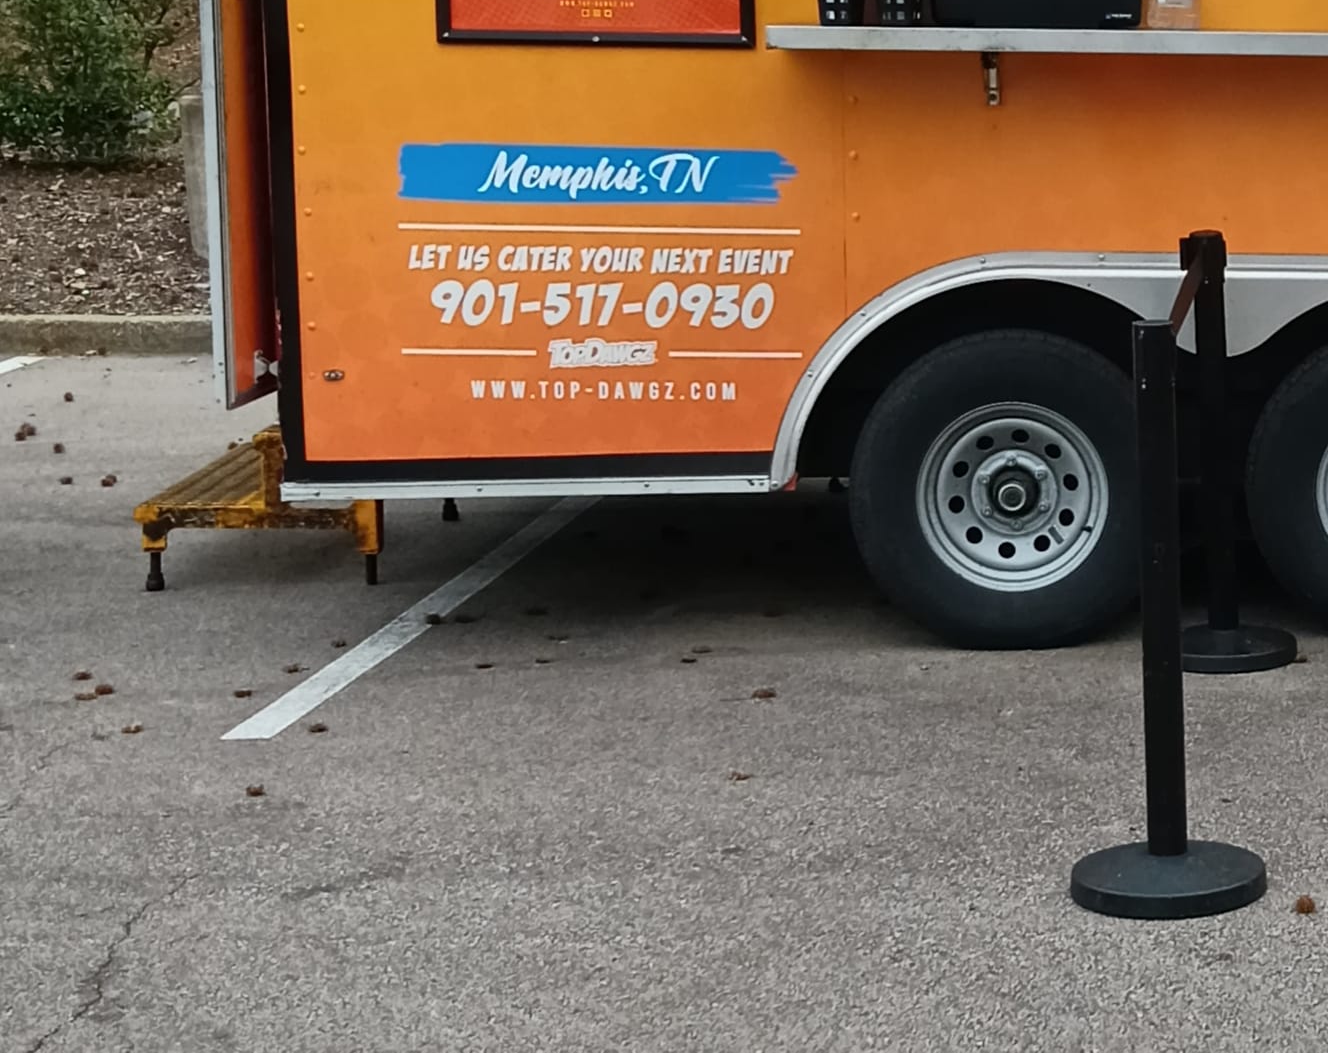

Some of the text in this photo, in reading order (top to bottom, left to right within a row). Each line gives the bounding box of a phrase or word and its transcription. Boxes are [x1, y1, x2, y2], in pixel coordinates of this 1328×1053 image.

[408, 245, 793, 275] LET US CATER YOUR NEXT EVENT
[431, 279, 774, 329] 901-517-0930
